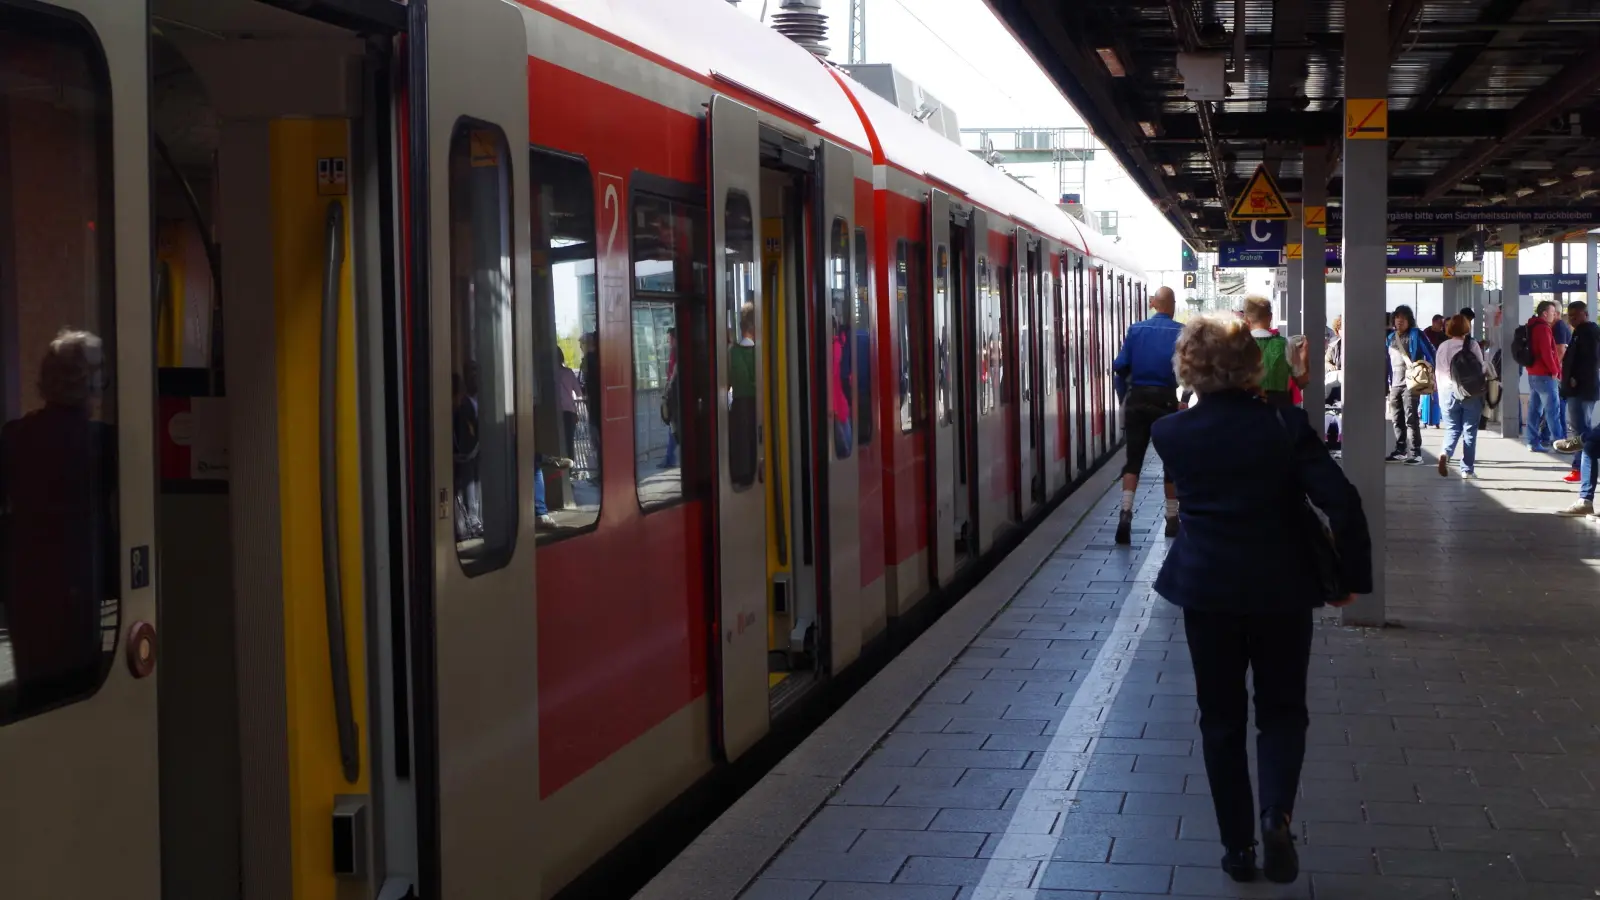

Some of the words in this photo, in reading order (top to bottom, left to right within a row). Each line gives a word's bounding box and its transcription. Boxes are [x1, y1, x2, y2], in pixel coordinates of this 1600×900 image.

[604, 183, 619, 262] 2
[1387, 211, 1413, 222] rgäste
[1414, 211, 1433, 220] bitte
[1455, 211, 1532, 220] Sicherheitsstreifen
[1533, 210, 1592, 220] zurückbleiben
[1250, 219, 1272, 243] C
[1186, 275, 1194, 288] P
